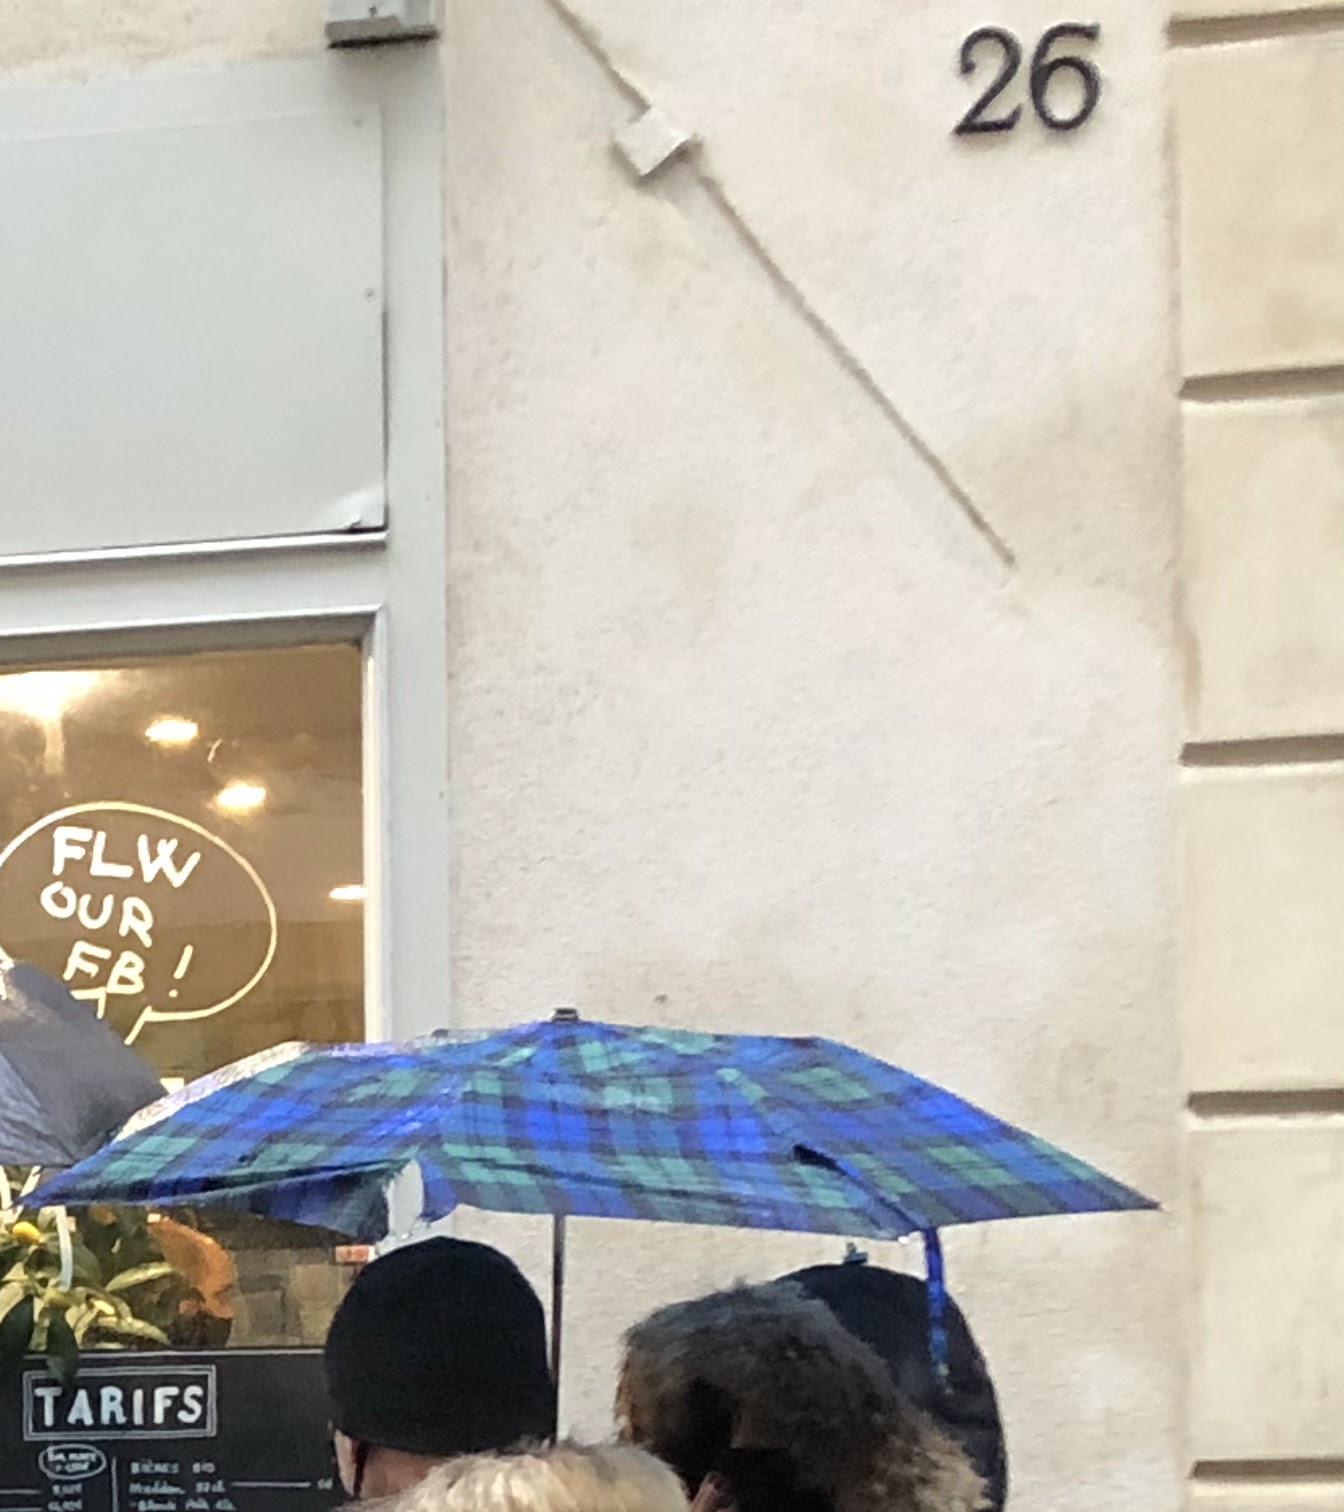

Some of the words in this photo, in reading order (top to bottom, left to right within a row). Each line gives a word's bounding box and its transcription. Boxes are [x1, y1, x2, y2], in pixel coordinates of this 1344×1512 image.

[952, 22, 1100, 134] 26
[53, 826, 201, 888] FLW
[40, 881, 154, 948] OUR
[34, 1385, 204, 1428] TARIFS
